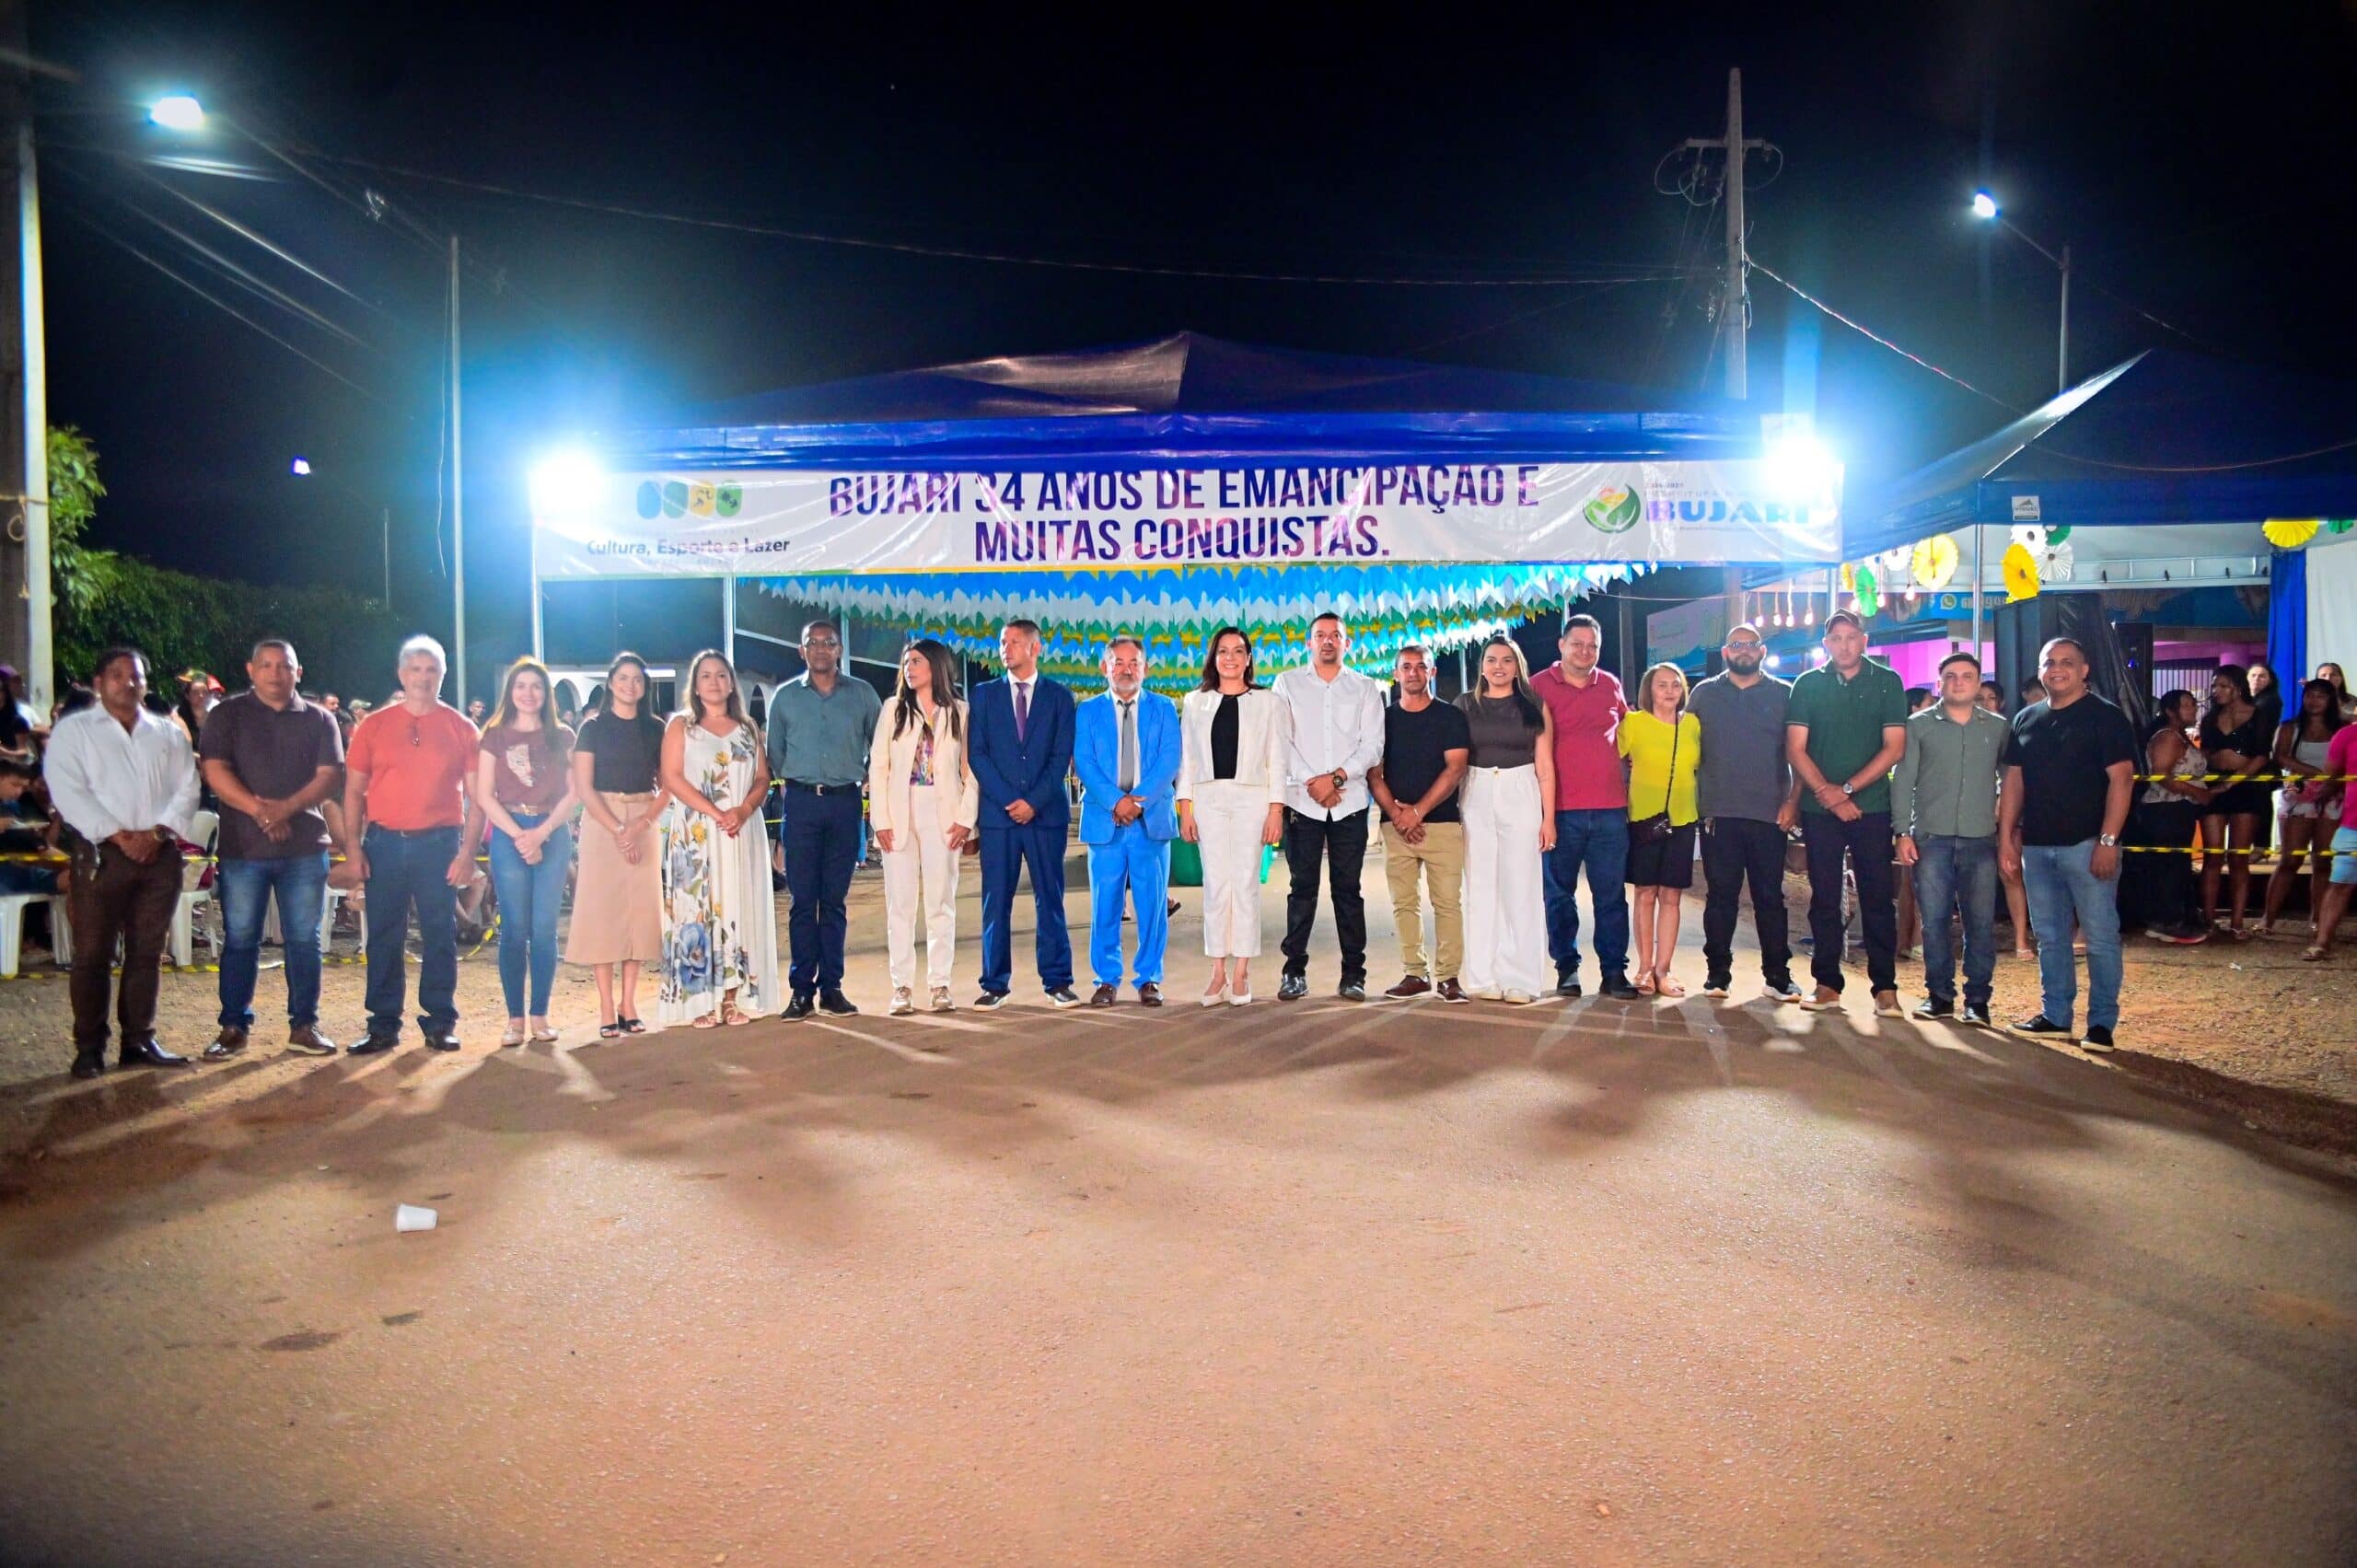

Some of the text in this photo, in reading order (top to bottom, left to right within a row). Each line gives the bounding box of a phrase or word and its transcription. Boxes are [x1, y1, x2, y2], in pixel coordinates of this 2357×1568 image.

[830, 472, 960, 517] BUJARI
[975, 472, 1025, 513] 34
[1038, 471, 1142, 512] ANOS
[1156, 470, 1204, 509] DE
[1518, 465, 1539, 506] E
[1646, 500, 1809, 523] BUJARI
[586, 537, 790, 556] Cultura, Esporte e Lazer
[975, 515, 1389, 562] MUITAS CONQUISTAS.
